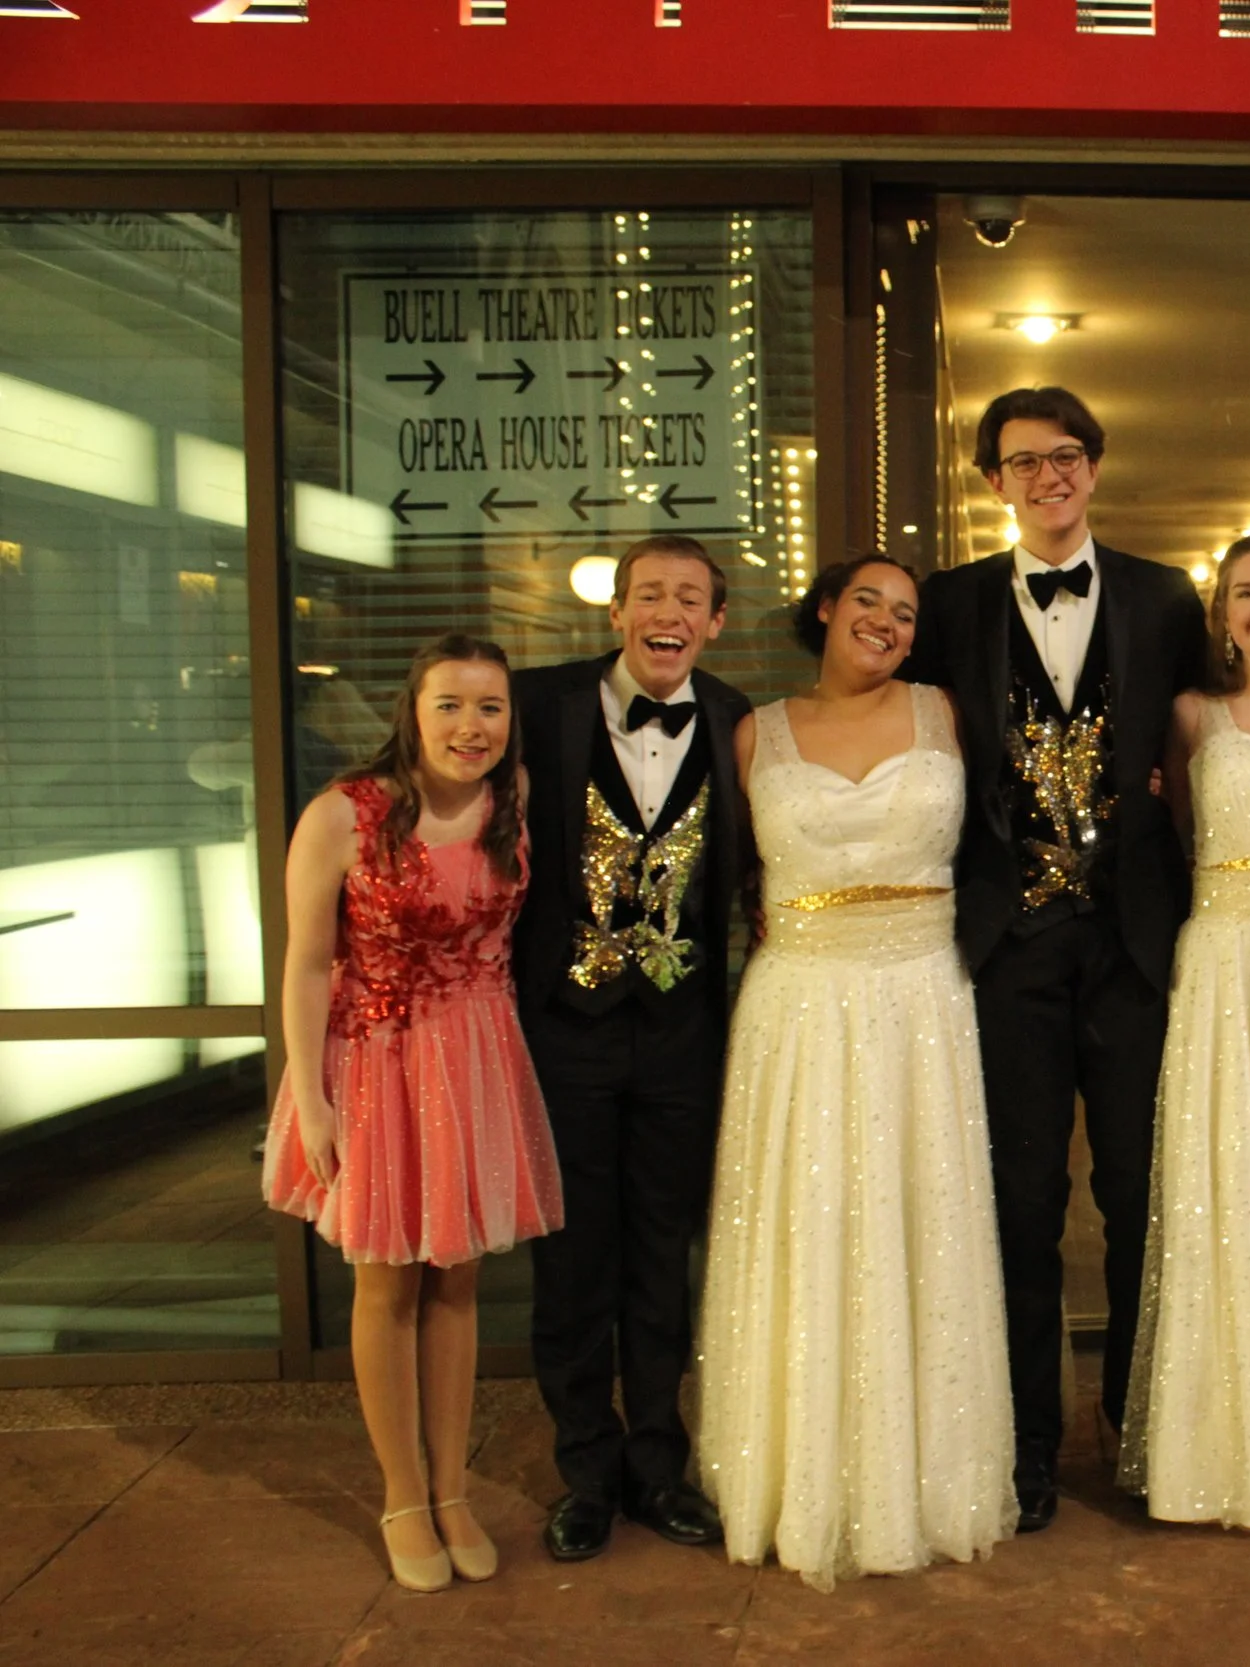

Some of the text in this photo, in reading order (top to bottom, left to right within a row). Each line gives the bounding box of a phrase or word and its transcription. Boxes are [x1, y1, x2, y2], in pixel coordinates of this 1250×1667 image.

[383, 284, 716, 344] BUELL THEATRE TICKETS
[398, 412, 707, 473] OPERA HOUSE TICKETS
